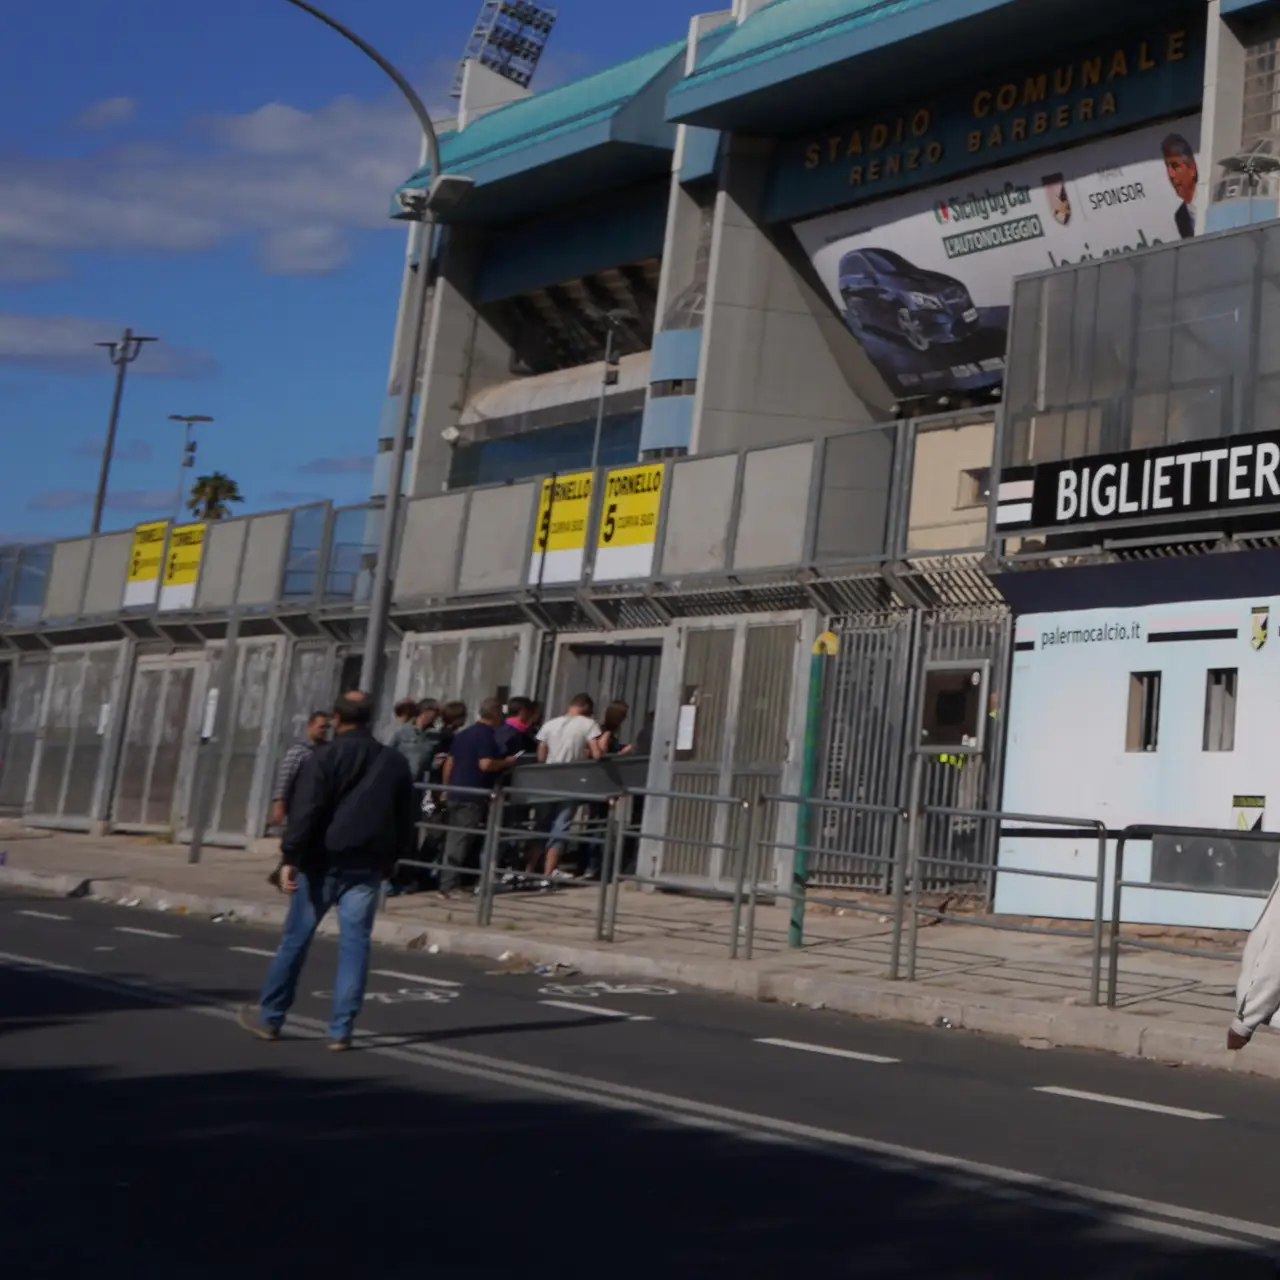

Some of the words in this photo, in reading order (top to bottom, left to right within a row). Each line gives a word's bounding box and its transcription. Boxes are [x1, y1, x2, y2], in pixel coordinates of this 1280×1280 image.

[804, 108, 931, 170] STADIO
[972, 30, 1189, 118] COMUNALE
[849, 142, 943, 187] RENZO
[967, 91, 1117, 154] BARBERA
[1088, 182, 1147, 211] SPONSOR
[603, 503, 617, 543] 5
[1041, 620, 1141, 650] palermocalcio.it
